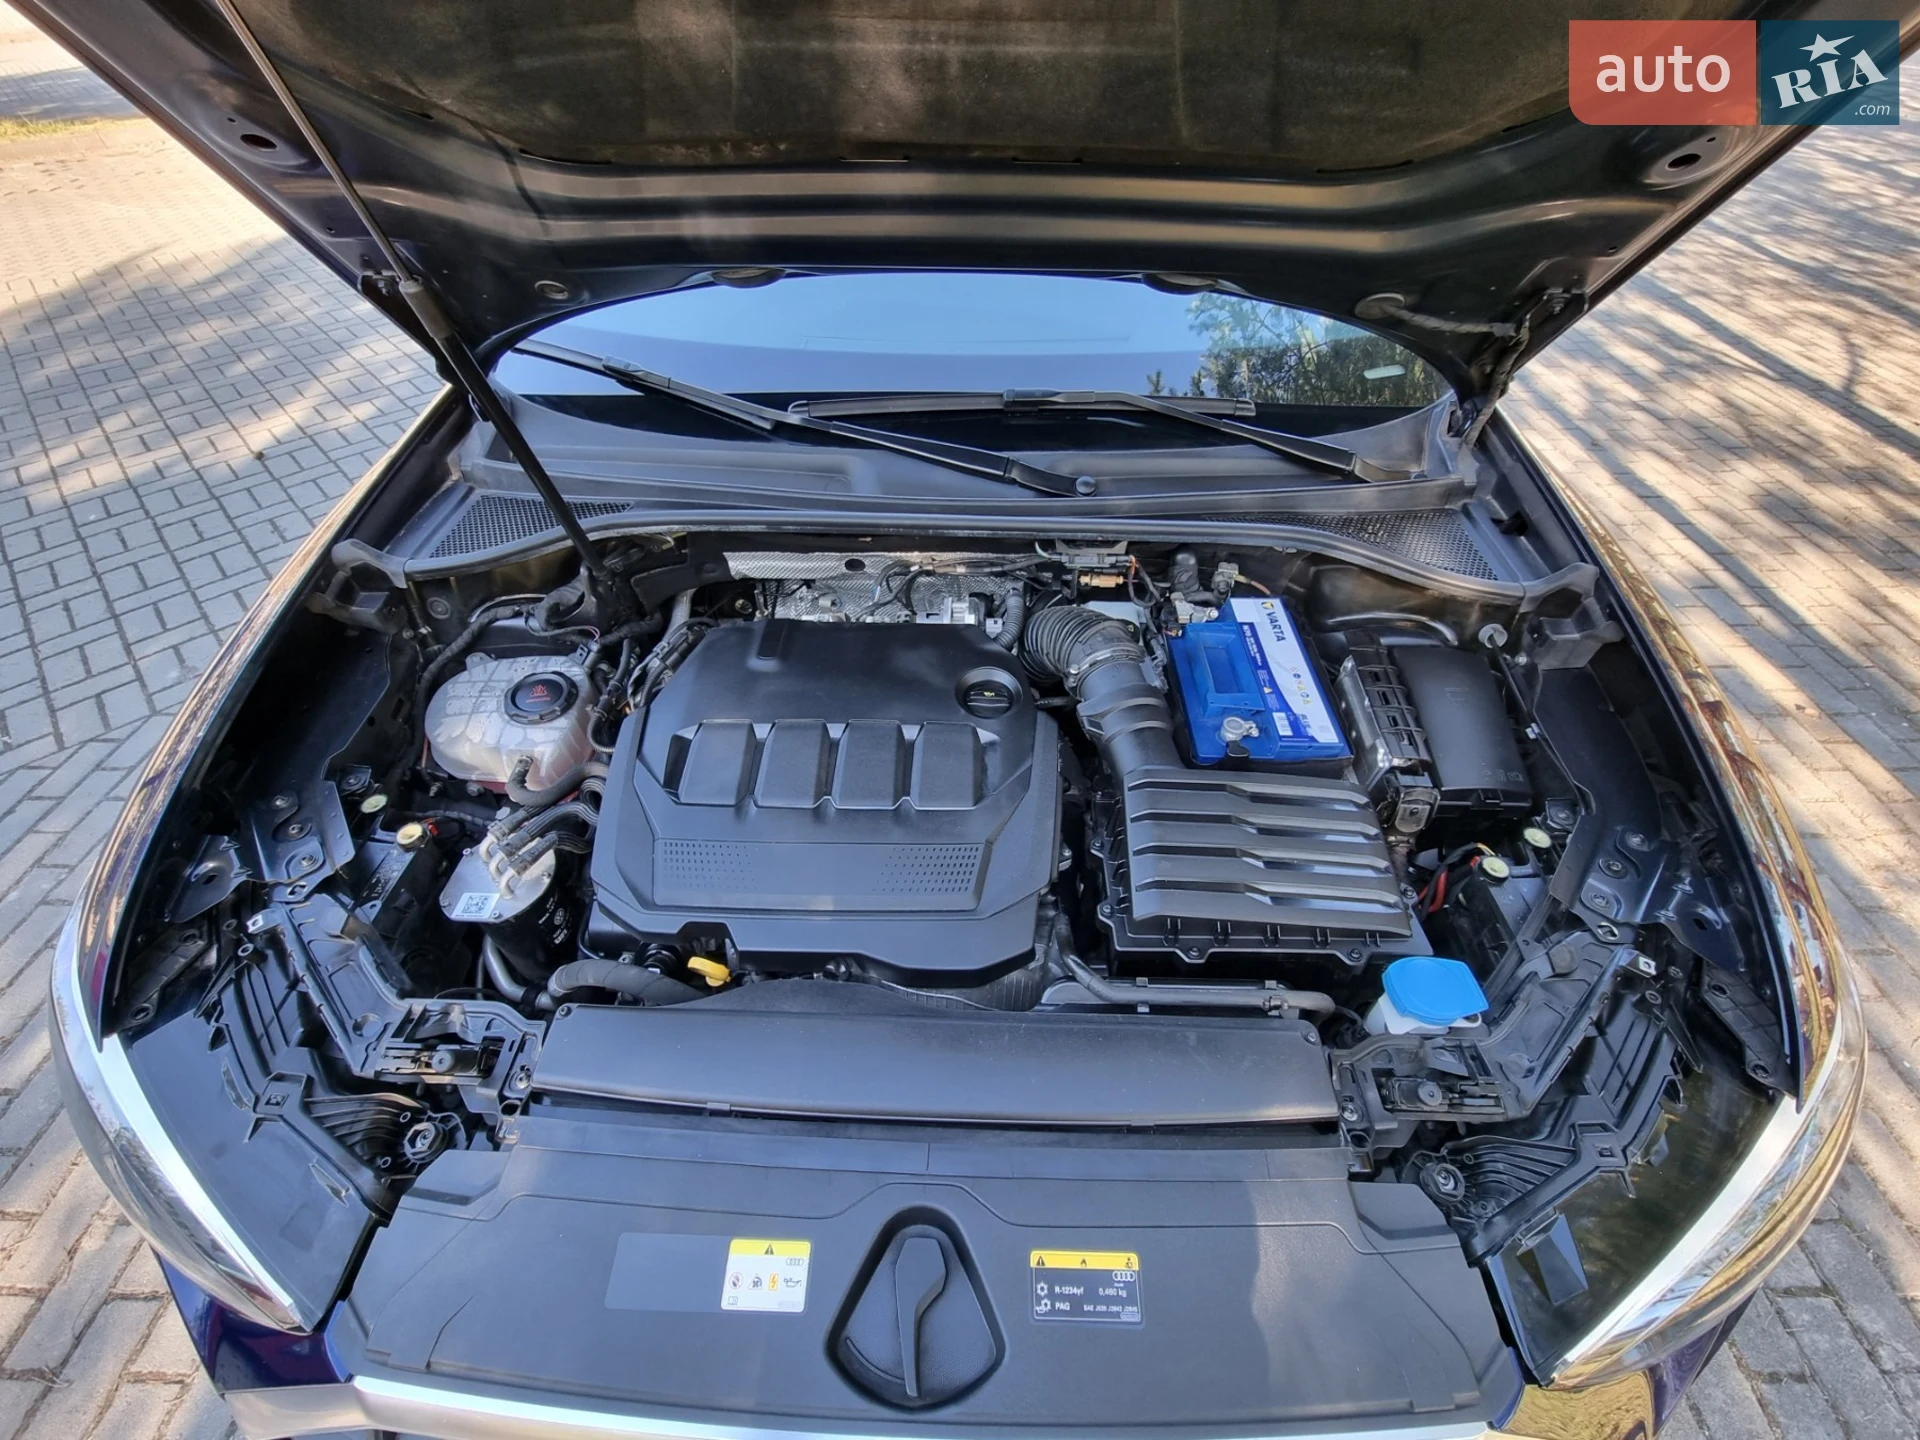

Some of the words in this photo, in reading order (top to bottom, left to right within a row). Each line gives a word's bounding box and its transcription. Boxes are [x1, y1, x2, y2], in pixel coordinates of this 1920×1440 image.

[1266, 611, 1286, 642] VARTA
[1054, 1286, 1084, 1297] R-1234yf
[1118, 1287, 1127, 1298] kg
[1055, 1302, 1070, 1310] PAG
